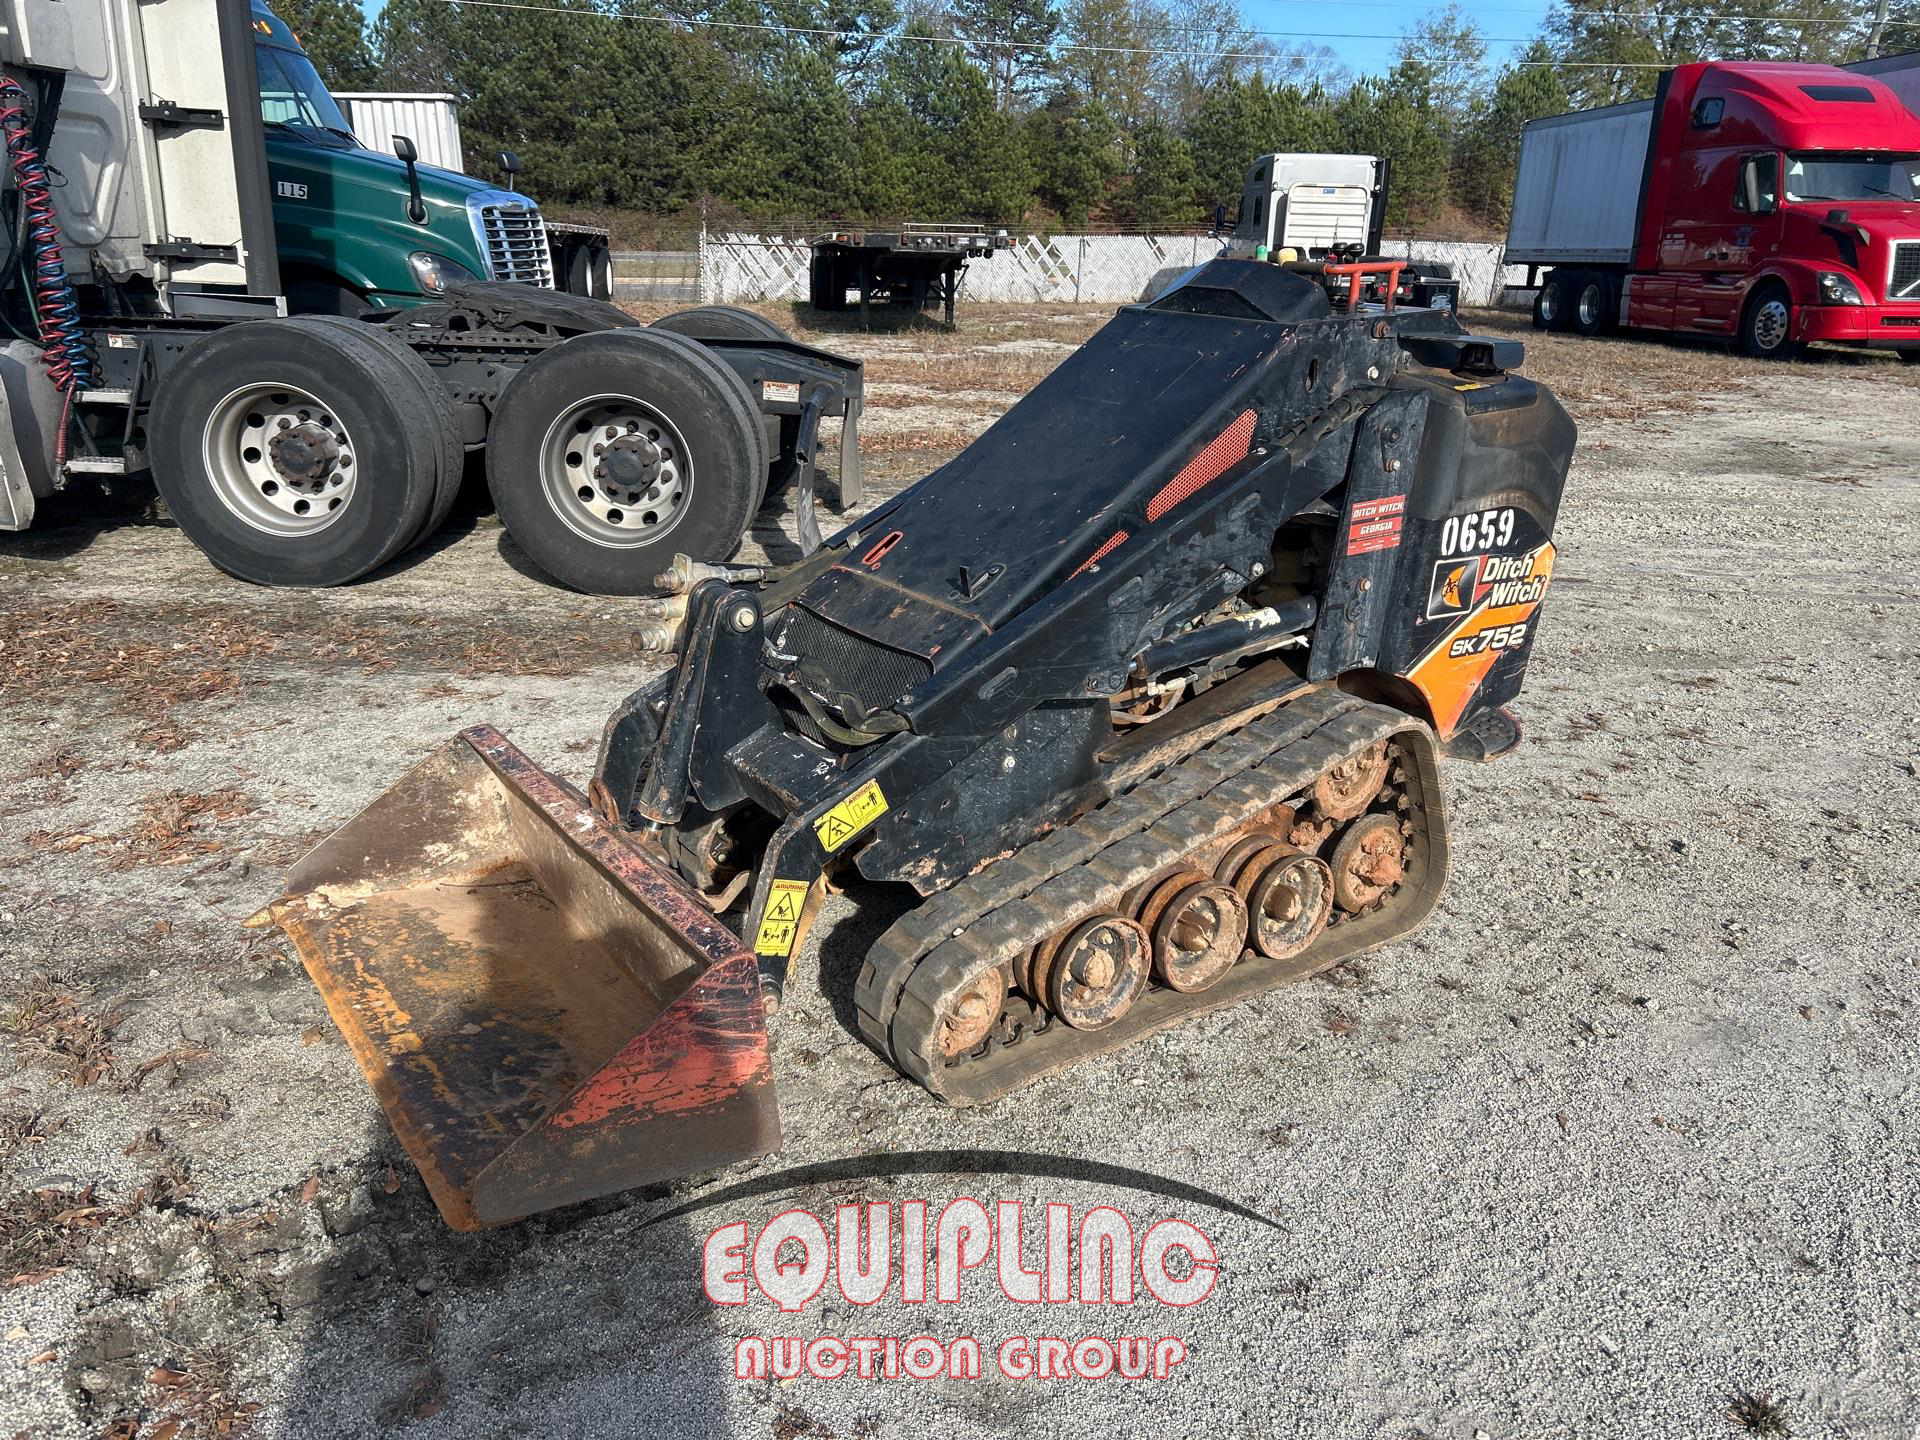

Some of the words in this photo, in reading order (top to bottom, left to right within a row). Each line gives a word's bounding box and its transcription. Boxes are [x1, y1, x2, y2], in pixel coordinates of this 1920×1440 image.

[280, 183, 306, 197] 115
[1353, 506, 1377, 518] DITCH
[1378, 501, 1404, 513] WITCH
[1360, 521, 1393, 535] GEORGIA
[1441, 508, 1515, 556] 0659
[1481, 553, 1534, 583] Ditch
[1489, 577, 1541, 608] Witch
[780, 883, 806, 891] WARNING
